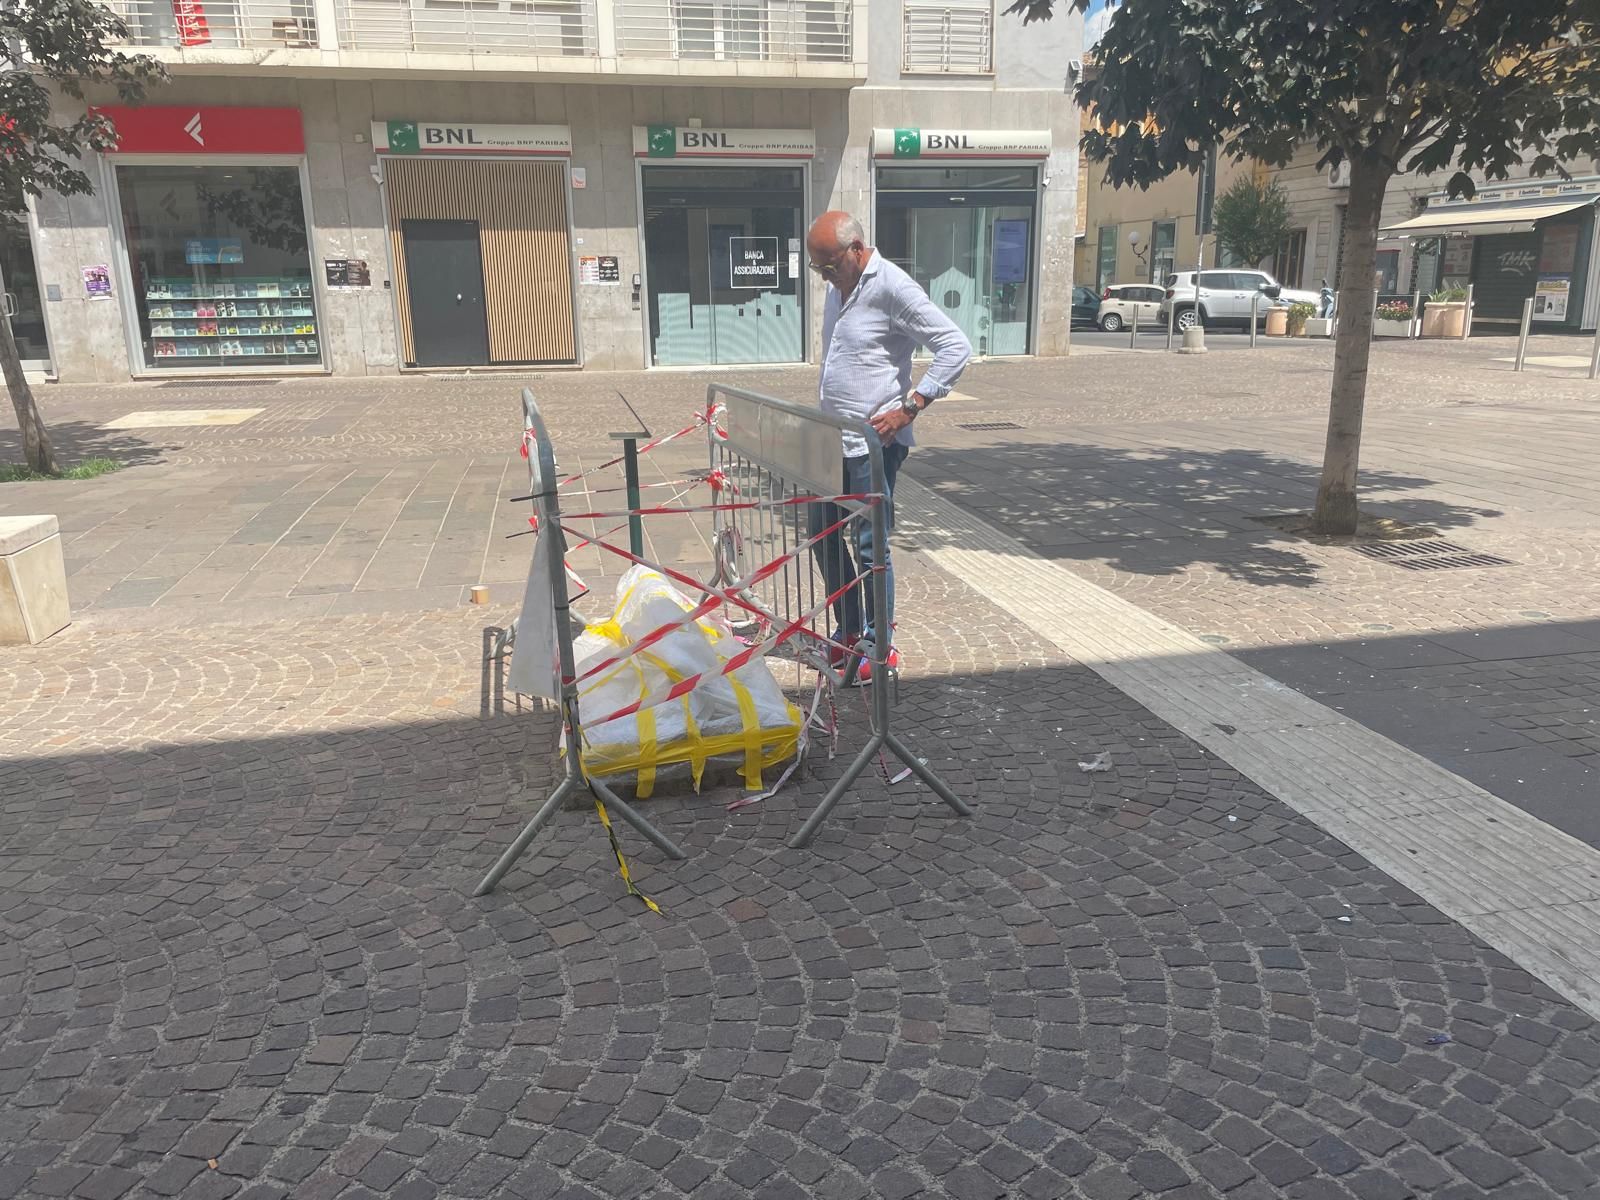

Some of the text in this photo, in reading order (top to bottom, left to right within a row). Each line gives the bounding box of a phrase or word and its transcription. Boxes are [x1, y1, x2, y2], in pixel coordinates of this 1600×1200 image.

[425, 127, 483, 145] BNL
[487, 139, 515, 147] Gruppo
[535, 139, 569, 147] PARIBAS
[682, 131, 734, 149] BNL
[927, 134, 974, 150] BNL
[744, 250, 765, 260] BANCA
[734, 265, 775, 275] ASSICURAZIONE
